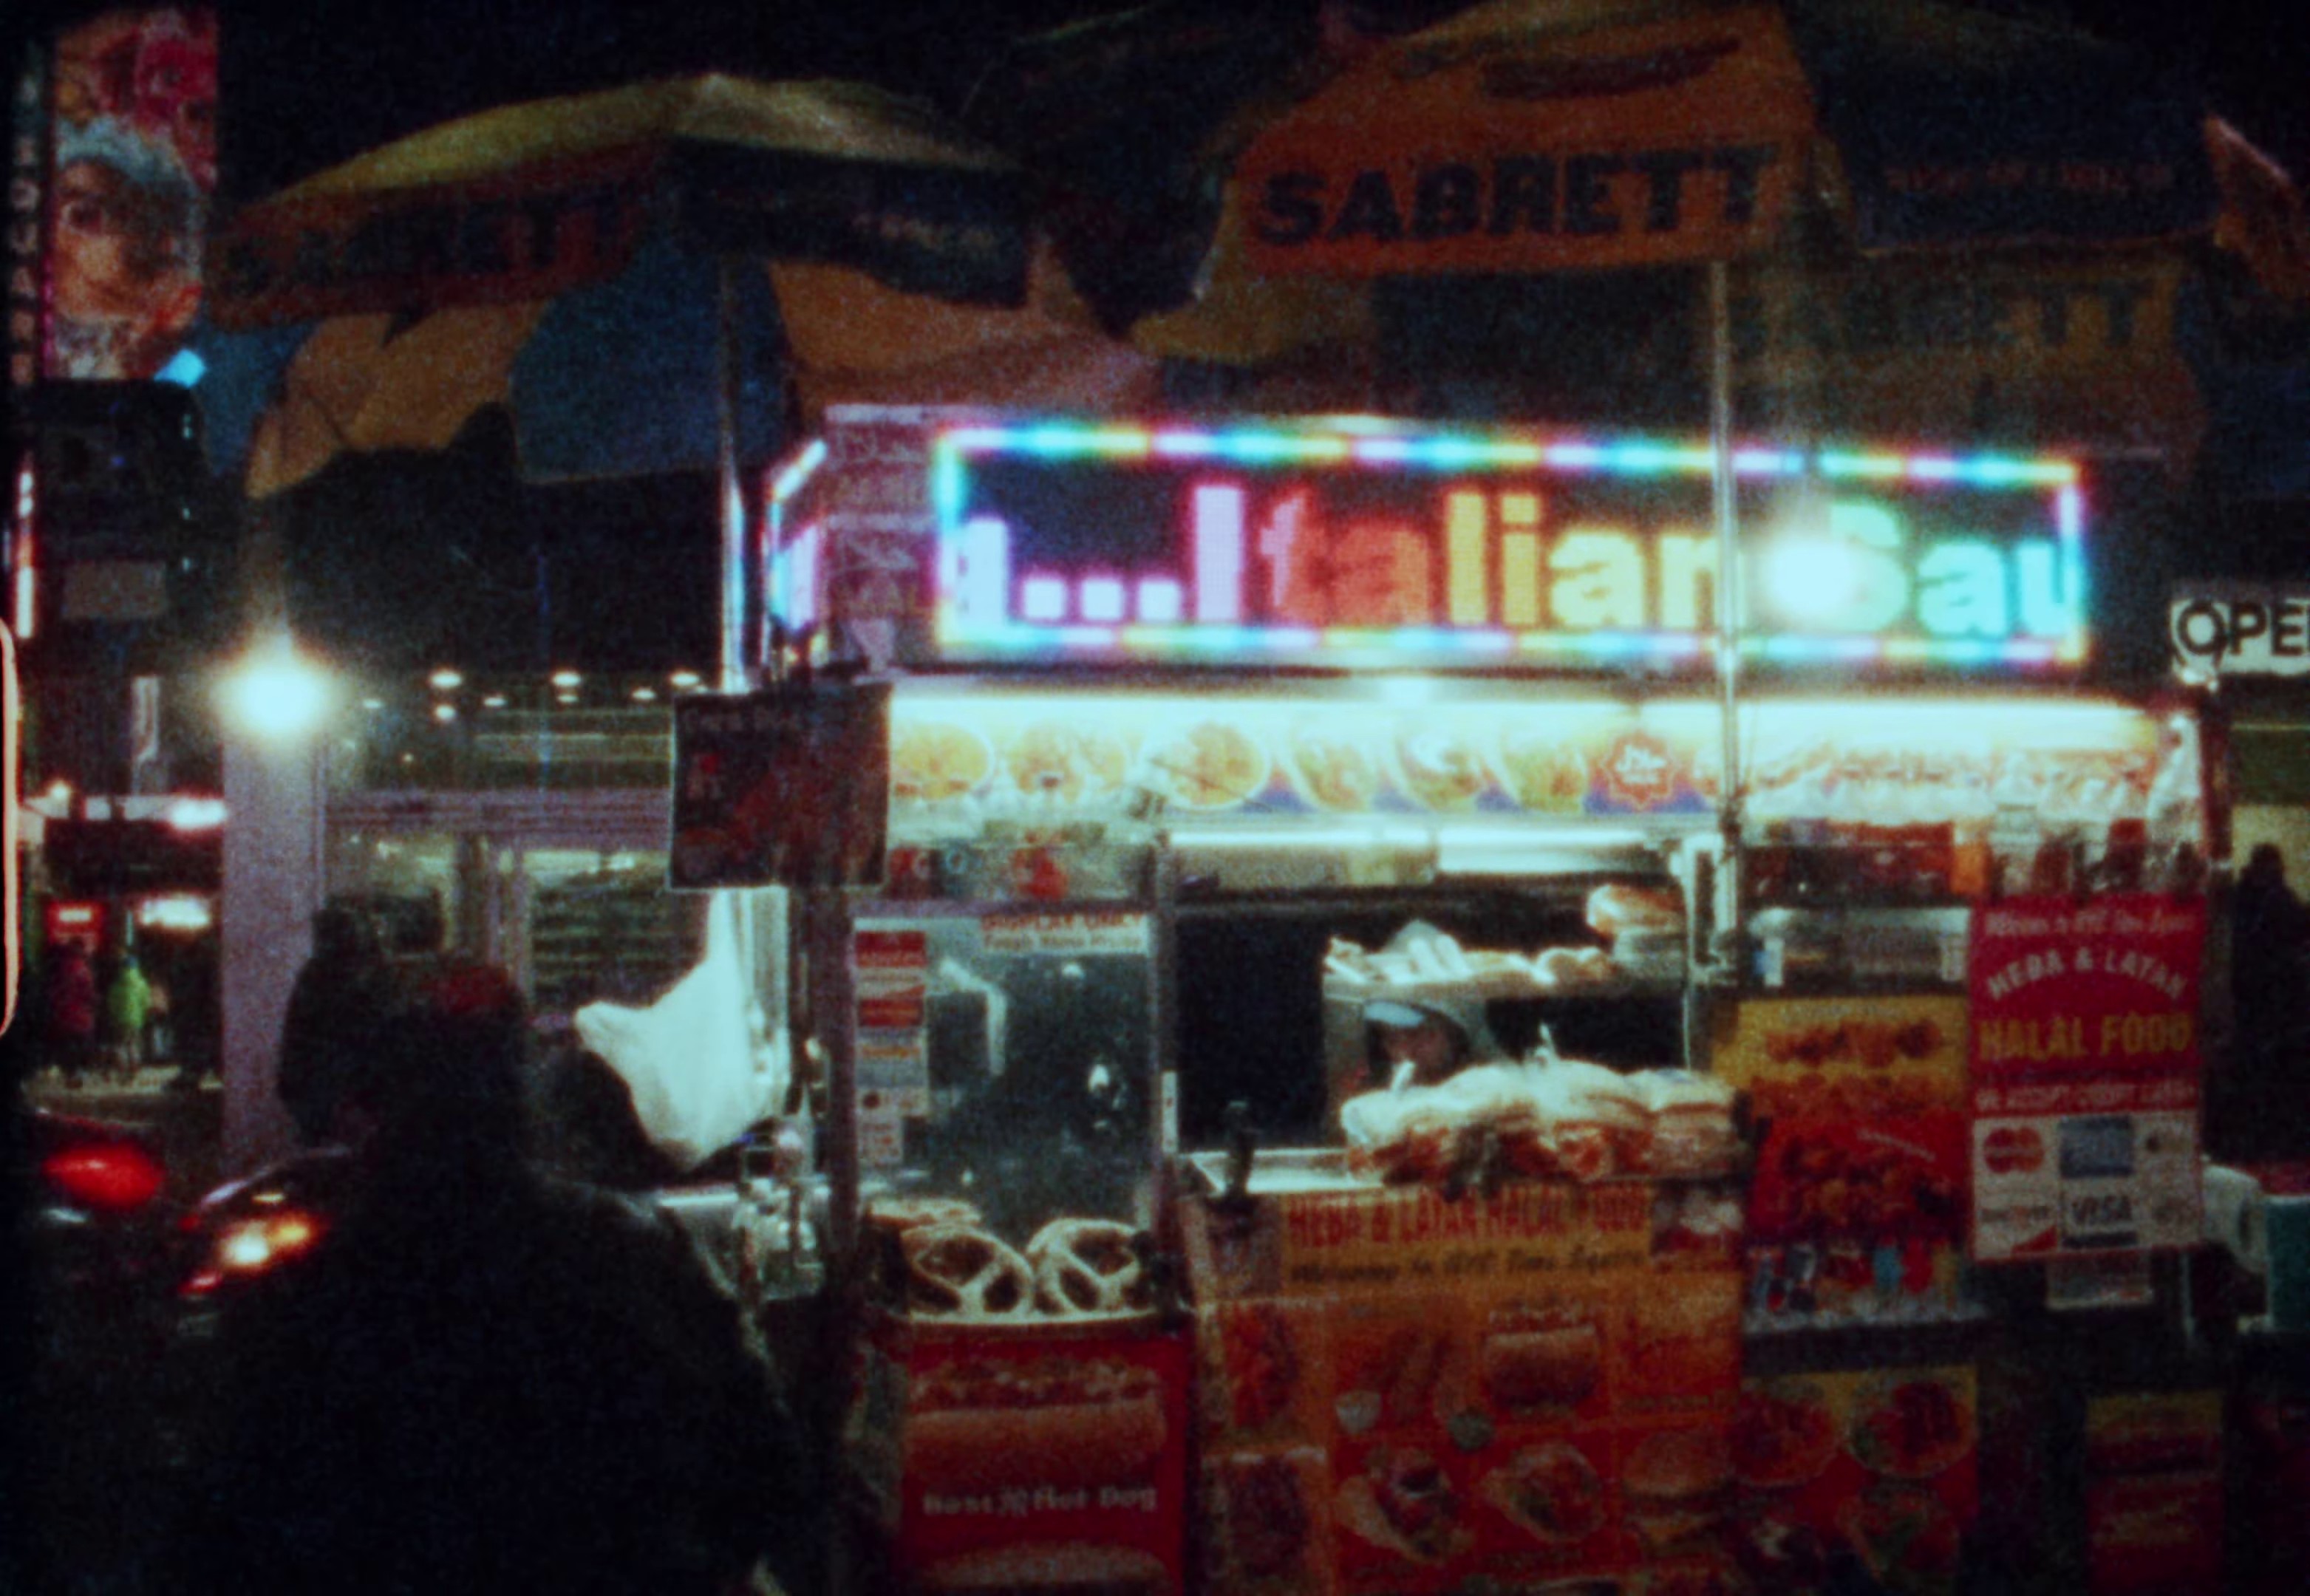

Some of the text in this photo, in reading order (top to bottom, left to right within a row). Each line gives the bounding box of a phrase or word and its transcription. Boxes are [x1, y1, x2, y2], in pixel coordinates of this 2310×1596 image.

[1254, 151, 1775, 248] SABRETT
[1193, 485, 1745, 630] Italian
[2178, 601, 2310, 657] OPE
[1977, 1010, 2192, 1061] HALAL FOOD
